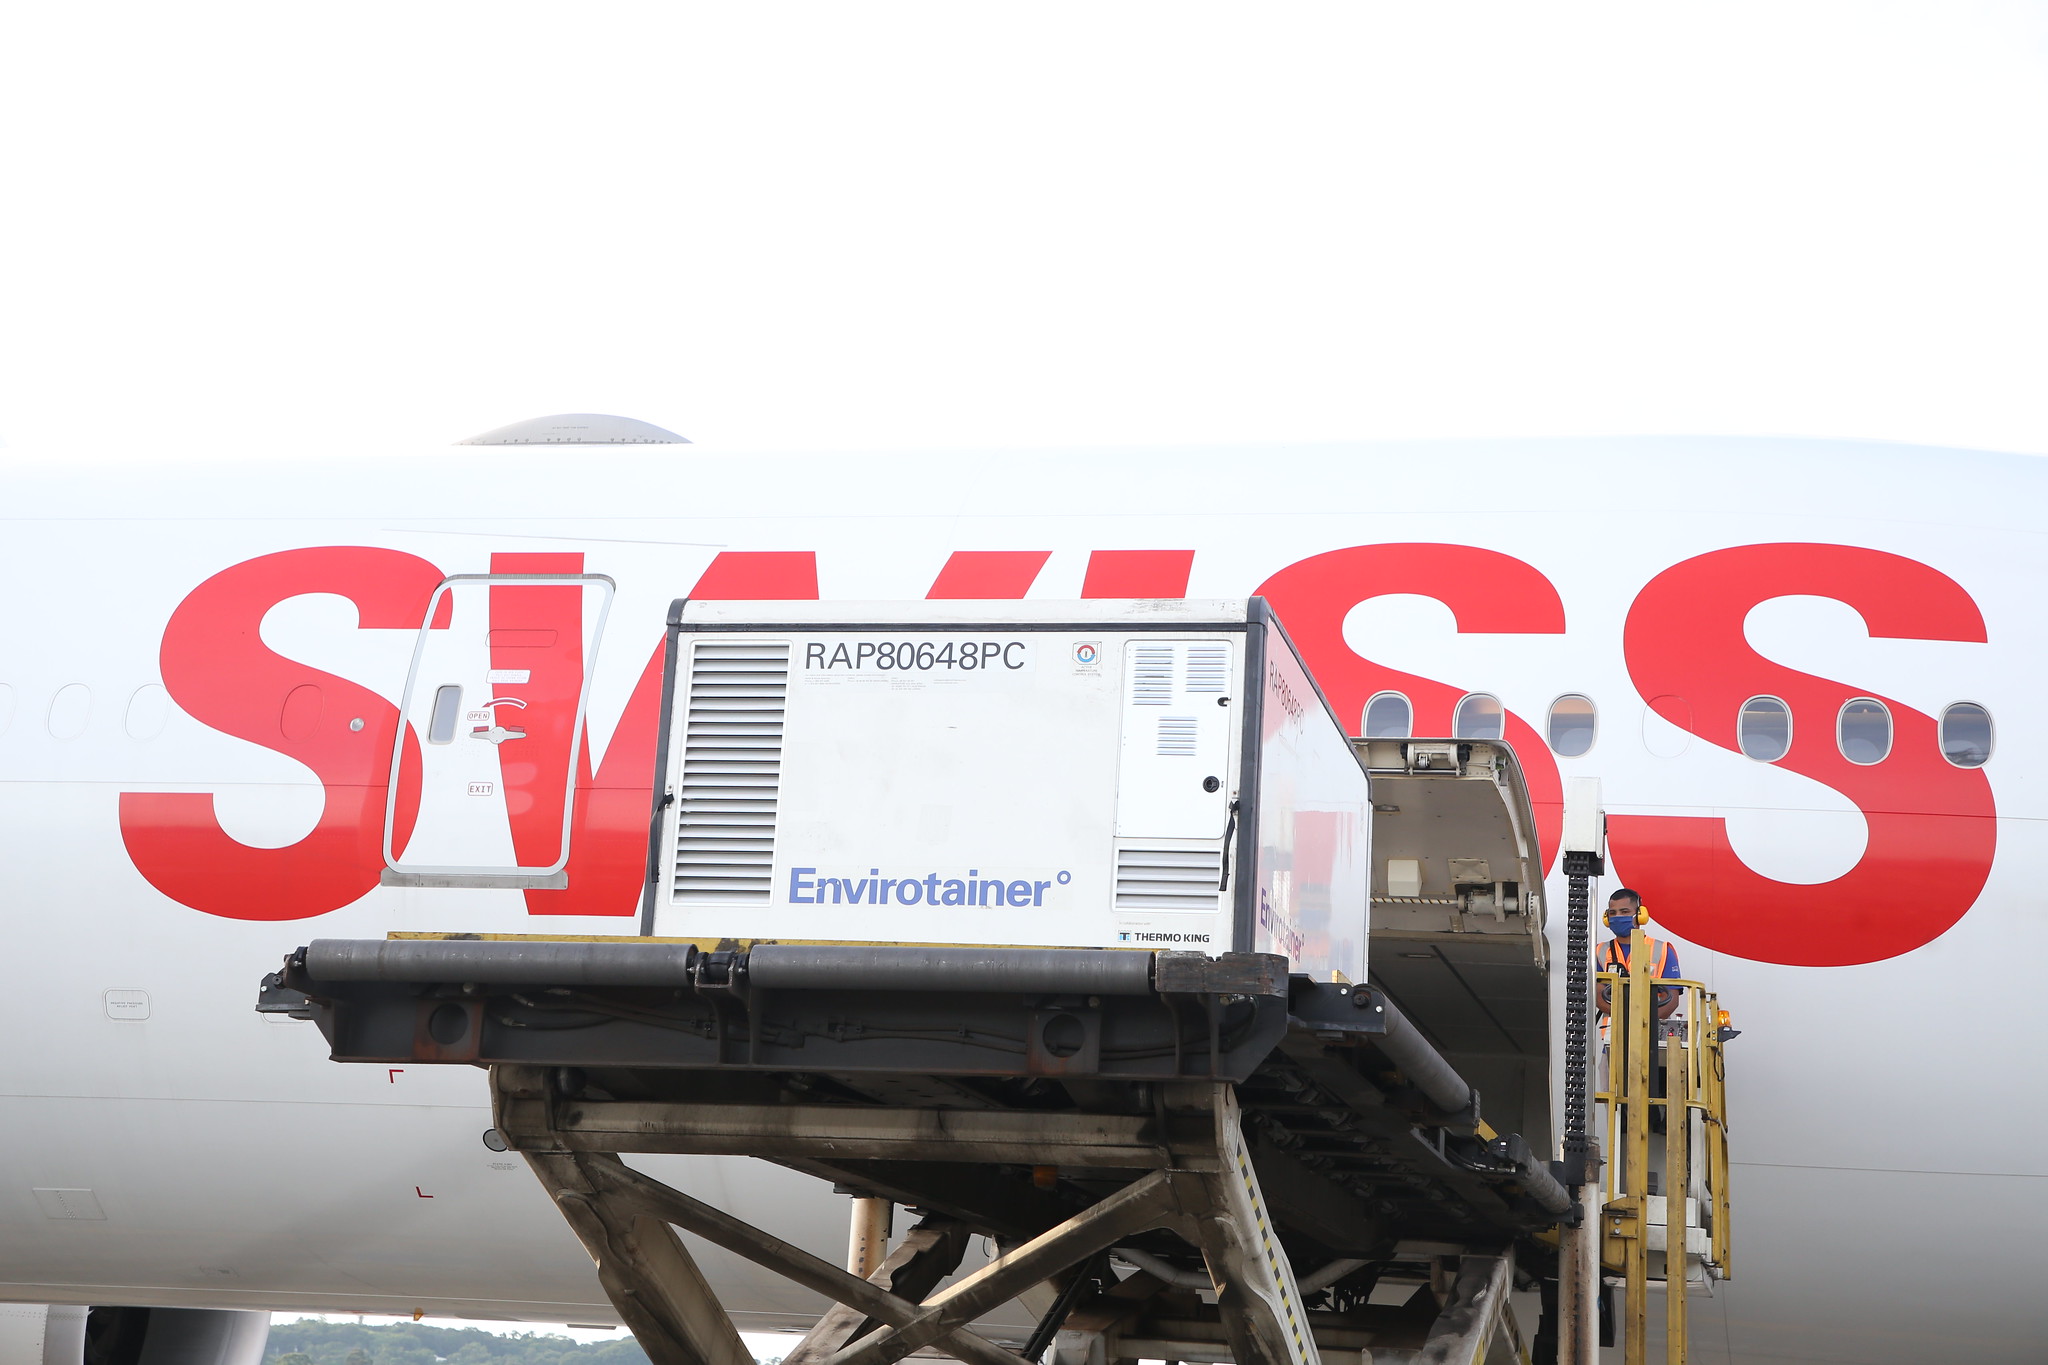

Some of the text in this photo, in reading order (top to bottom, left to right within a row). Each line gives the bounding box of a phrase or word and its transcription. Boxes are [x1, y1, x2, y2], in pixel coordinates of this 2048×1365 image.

[805, 641, 1026, 671] RAP80648PC
[120, 542, 1997, 968] SSS
[469, 785, 492, 793] EXIT
[1134, 932, 1182, 943] THERMO
[1183, 933, 1210, 943] KING
